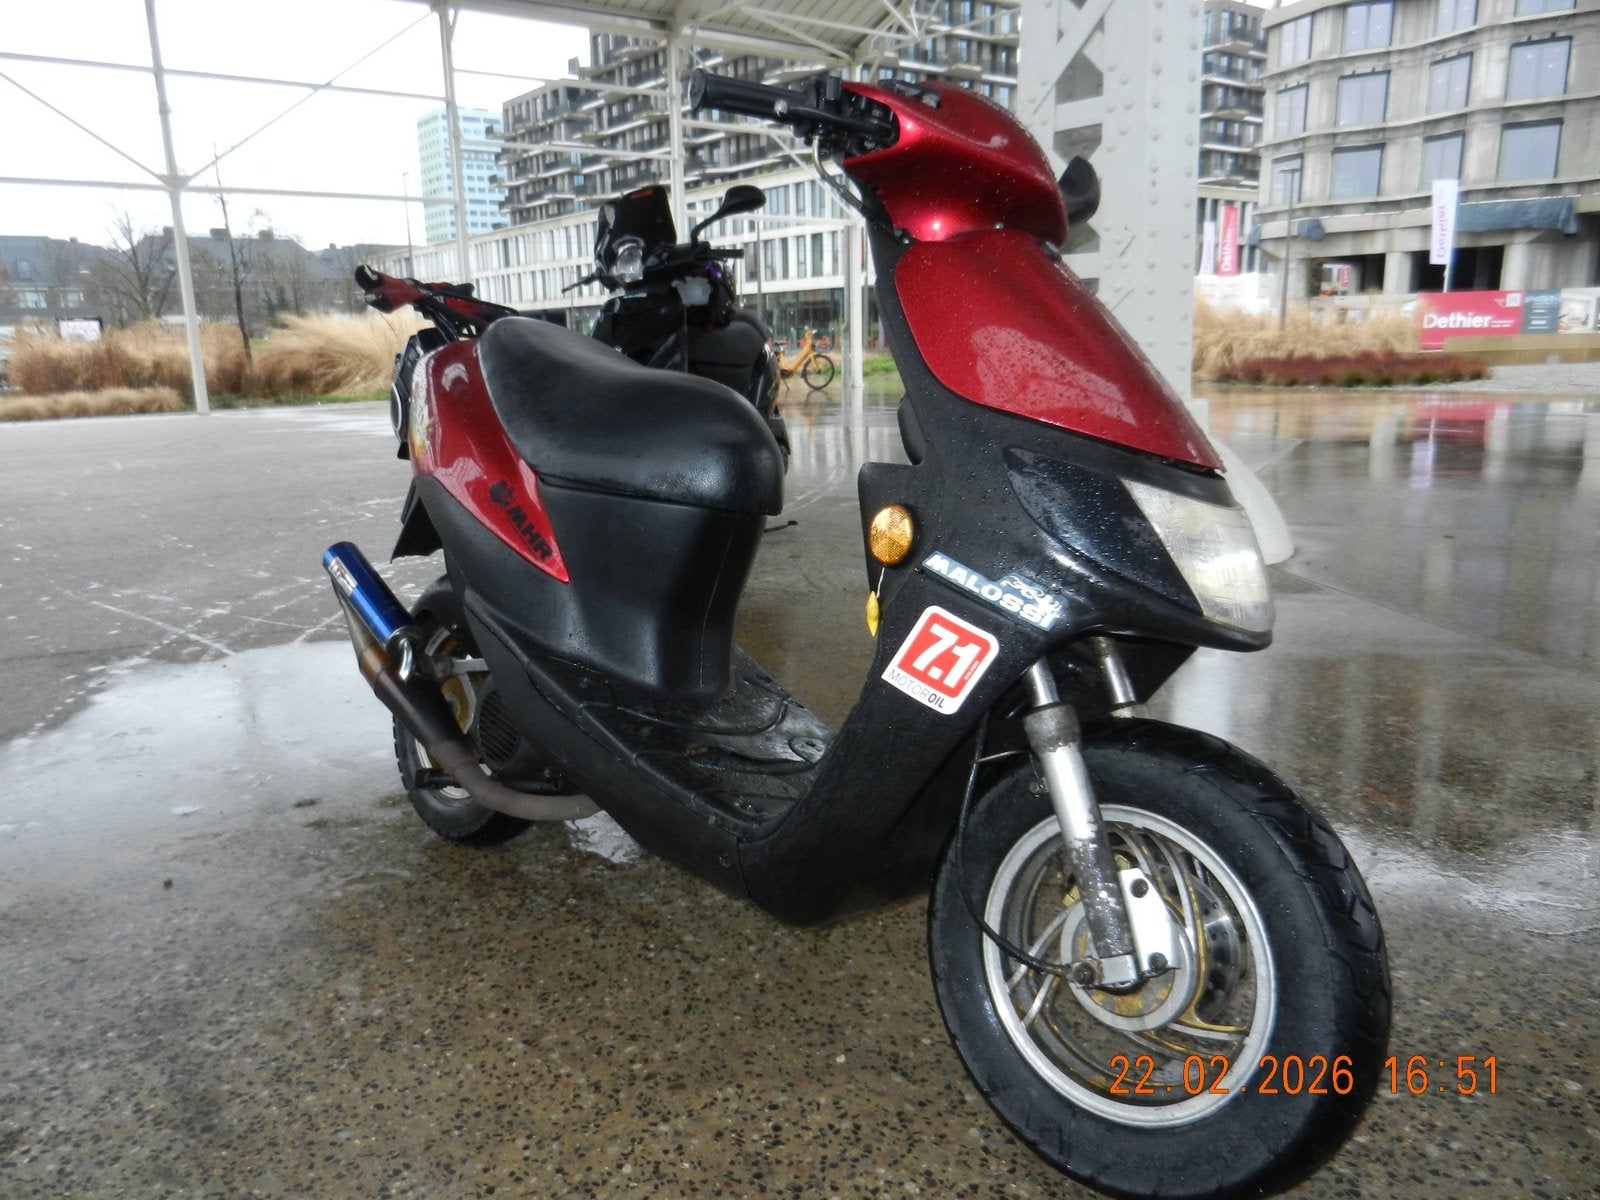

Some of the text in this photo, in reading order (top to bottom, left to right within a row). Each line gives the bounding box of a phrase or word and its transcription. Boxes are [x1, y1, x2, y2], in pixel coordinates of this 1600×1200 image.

[1423, 312, 1492, 329] Dethier
[925, 554, 1056, 628] MALOSSI
[912, 623, 982, 689] 7.1
